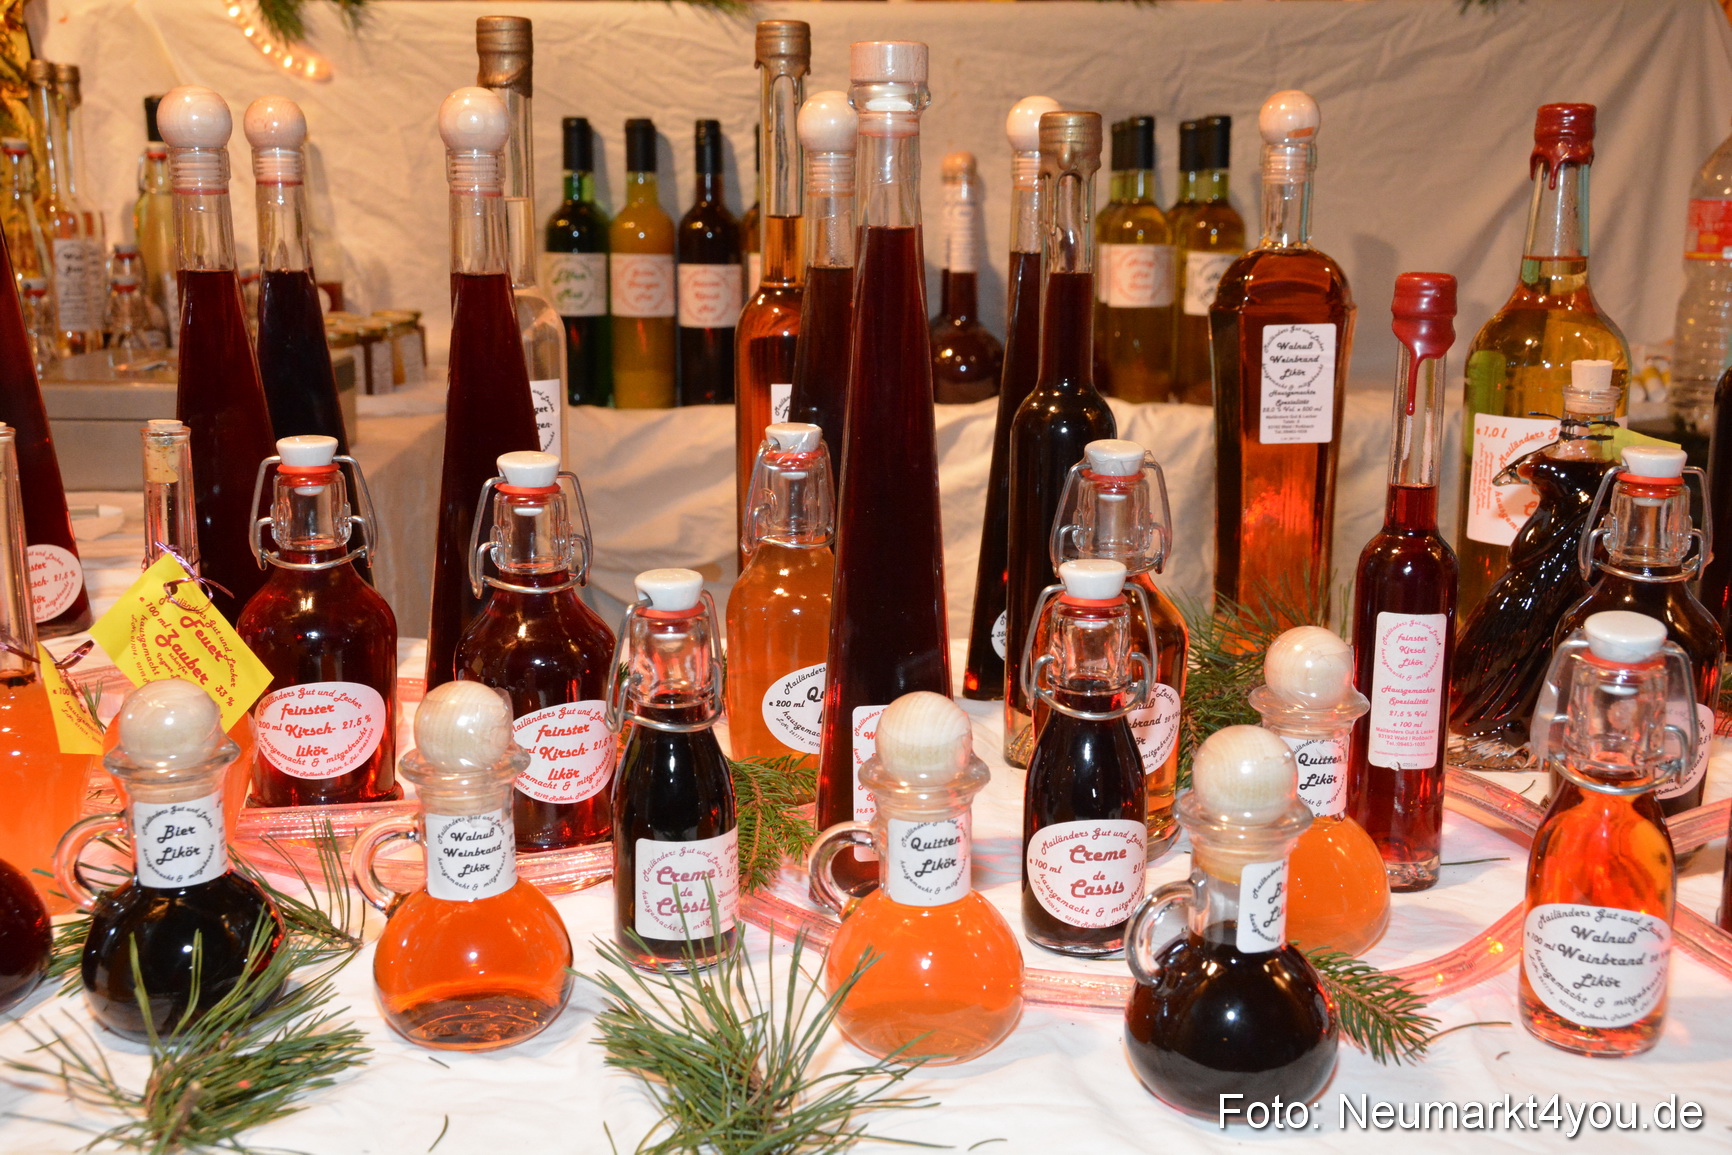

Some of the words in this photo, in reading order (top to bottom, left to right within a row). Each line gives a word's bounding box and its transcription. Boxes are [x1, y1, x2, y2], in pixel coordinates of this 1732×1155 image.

[1280, 369, 1305, 380] Likör
[54, 572, 68, 581] 21,5
[146, 602, 160, 617] 100
[158, 617, 172, 629] ml
[205, 619, 221, 636] Gut
[136, 615, 160, 676] hausgemacht
[180, 616, 224, 662] Feuer
[219, 636, 232, 652] und
[1396, 633, 1428, 643] feinster
[155, 628, 209, 685] Zauber
[1399, 646, 1426, 654] Kirsch
[223, 655, 236, 688] Lecker
[1398, 658, 1424, 668] Likör
[784, 667, 826, 695] Mailänders
[215, 684, 228, 698] 33
[228, 696, 235, 706] %
[1156, 688, 1175, 705] Lecker
[1381, 686, 1436, 696] Hausgemachte
[259, 692, 295, 716] Mailänders
[298, 688, 315, 699] Gut
[334, 692, 362, 709] Lecker
[1389, 697, 1429, 706] Spezialität
[281, 704, 334, 720] feinster
[558, 707, 576, 719] Gut
[258, 721, 270, 729] 200
[285, 722, 336, 738] Kirsch-
[342, 718, 362, 730] 21,5
[365, 714, 372, 723] %
[783, 711, 820, 737] hausgemac
[536, 724, 590, 742] feinster
[1142, 724, 1175, 759] mitgebracht
[261, 732, 306, 765] hausgemacht
[312, 758, 320, 767] &
[326, 727, 368, 763] mitgebracht
[296, 745, 329, 757] likör
[539, 743, 588, 761] Kirsch-
[593, 739, 608, 751] 21,5
[1298, 753, 1342, 766] Quitten
[548, 768, 580, 780] likör
[563, 782, 570, 790] &
[577, 748, 610, 787] mitgebracht
[1299, 773, 1337, 790] Likör
[170, 805, 185, 815] Gut
[156, 825, 196, 844] Bier
[450, 827, 495, 842] Walnuß
[1041, 831, 1088, 855] Mailänders
[1092, 828, 1111, 840] Gut
[443, 840, 502, 857] Weinbrand
[679, 847, 696, 857] Gut
[697, 849, 712, 858] und
[911, 836, 960, 852] Quitten
[156, 846, 200, 865] Likör
[1069, 844, 1127, 864] Creme
[458, 864, 490, 878] Likör
[914, 858, 956, 877] Likör
[1034, 859, 1048, 870] 100
[1049, 866, 1062, 874] ml
[656, 866, 716, 885] Creme
[1093, 871, 1106, 880] de
[680, 887, 693, 897] de
[1039, 873, 1090, 915] hausgemacht
[1095, 907, 1105, 917] &
[1070, 879, 1125, 898] Cassis
[642, 890, 677, 932] hausgemacht
[1537, 908, 1591, 929] Mailänders
[1595, 909, 1618, 923] Gut
[1620, 914, 1642, 925] und
[1531, 932, 1543, 945] 100
[1544, 942, 1556, 951] ml
[1570, 924, 1638, 944] Walnuß
[1557, 943, 1646, 966] Weinbrand
[1534, 948, 1588, 1004] hausgemacht
[1593, 997, 1605, 1008] &
[1572, 973, 1621, 990] Likör
